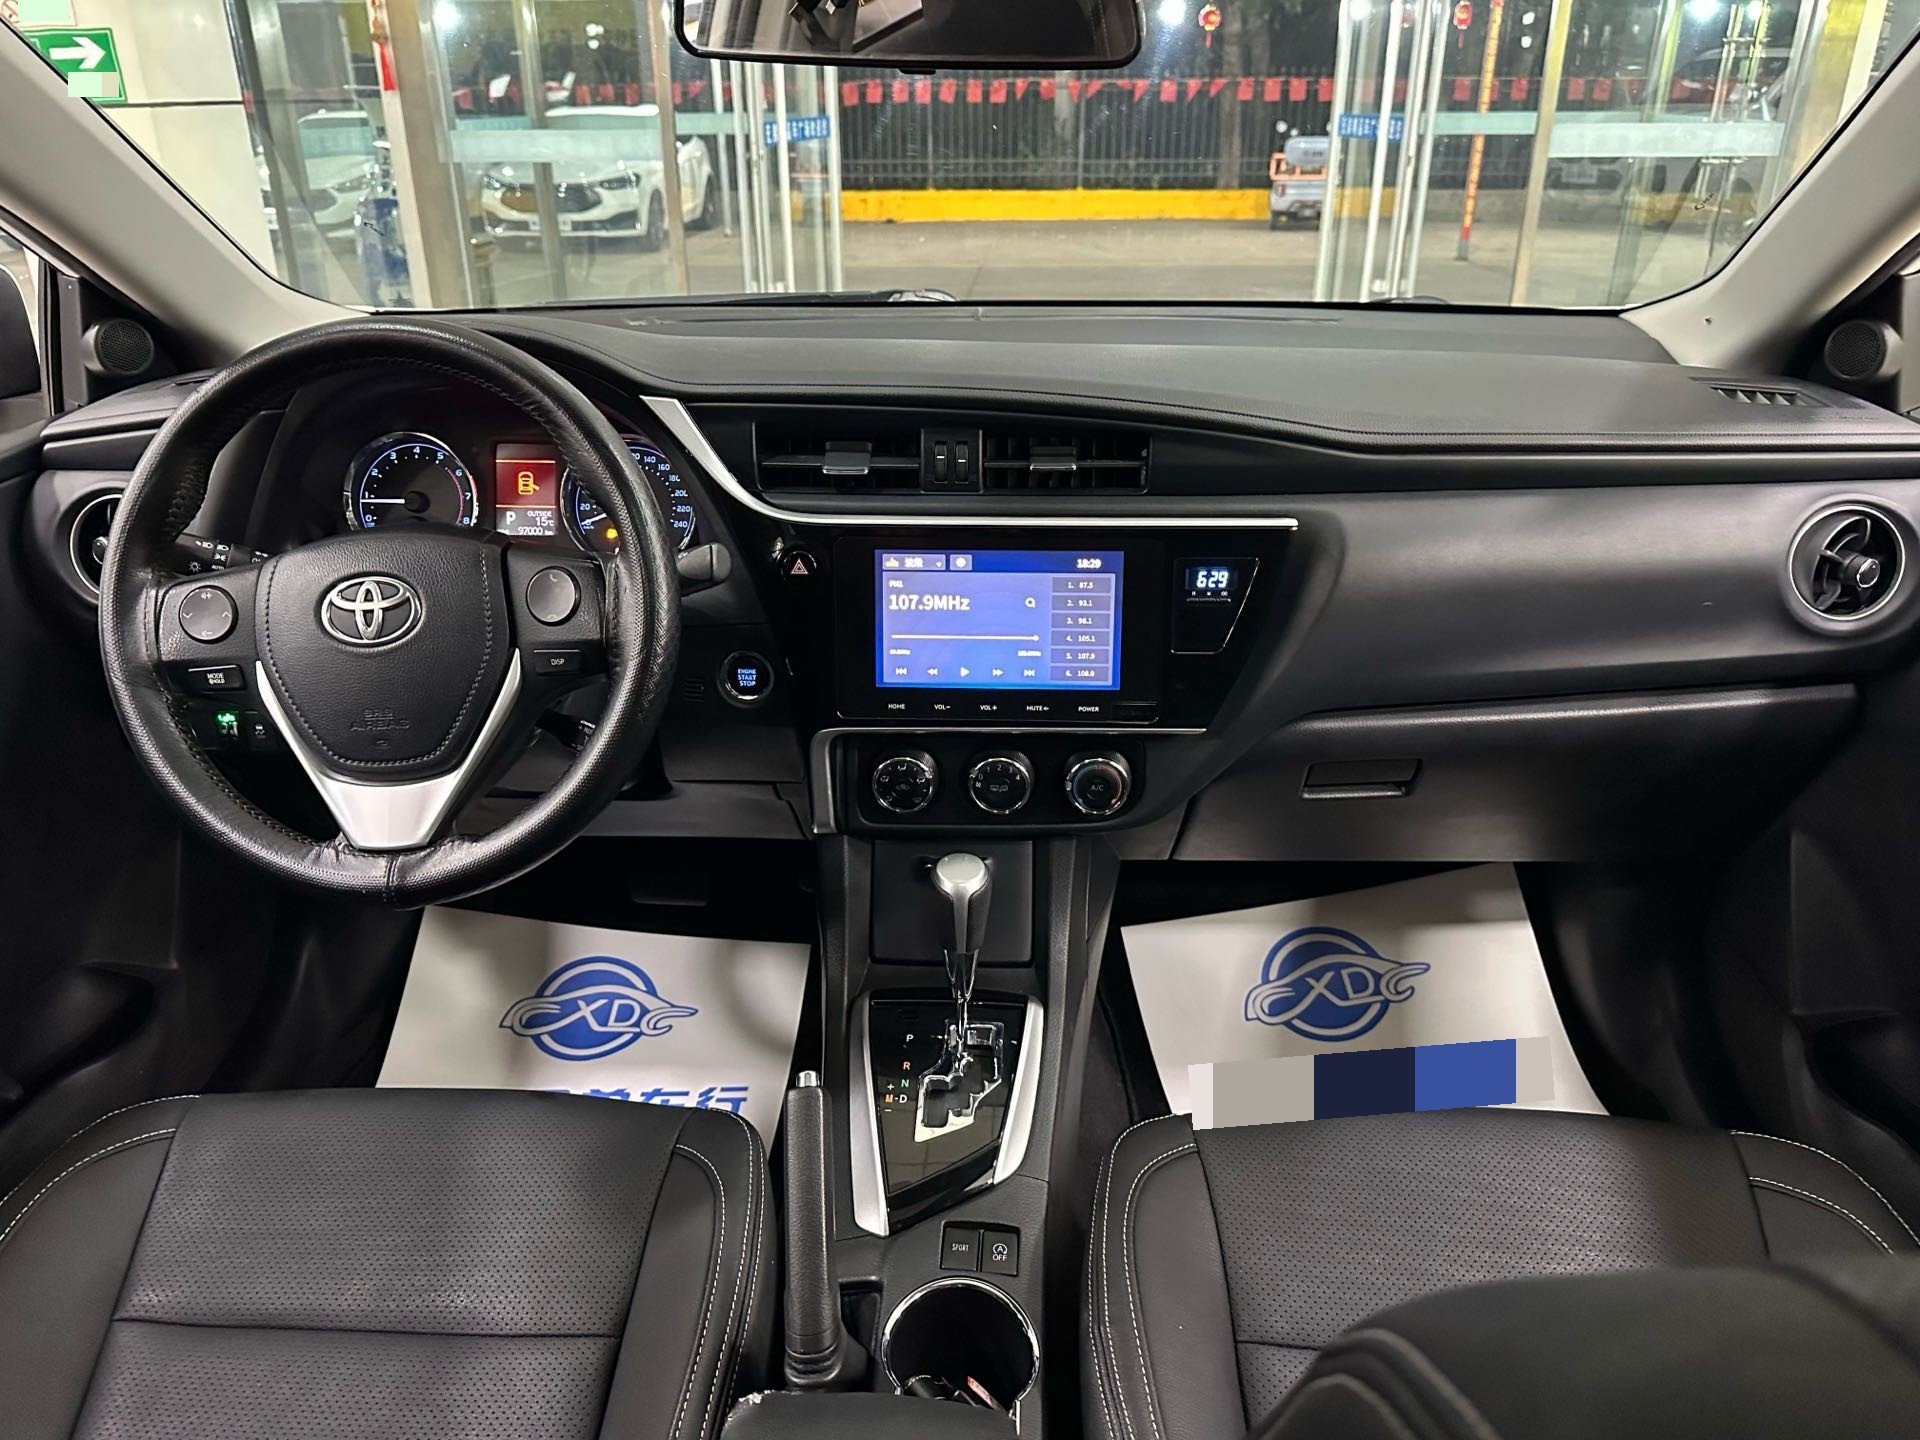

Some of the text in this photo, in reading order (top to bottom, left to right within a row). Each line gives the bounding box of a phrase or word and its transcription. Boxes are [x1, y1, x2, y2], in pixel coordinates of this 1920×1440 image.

[413, 446, 420, 454] 4
[390, 452, 397, 460] 3
[437, 452, 444, 460] 5
[643, 455, 656, 463] 140
[657, 463, 671, 471] 160
[371, 468, 379, 476] 2
[455, 469, 463, 477] 6
[464, 492, 472, 500] 7
[580, 503, 591, 511] 20
[676, 505, 691, 513] 220
[505, 510, 517, 526] P
[526, 510, 553, 518] OUTSIDE
[365, 514, 373, 523] 0
[462, 516, 470, 525] 8
[673, 520, 688, 528] 240
[1076, 558, 1102, 569] 18:29
[1078, 581, 1094, 590] 87.5
[888, 594, 971, 611] 107.9MHz
[1077, 652, 1096, 660] 107.9
[550, 658, 565, 666] DISP
[206, 672, 224, 680] MODE
[905, 1034, 914, 1043] P
[902, 1061, 911, 1070] R
[901, 1079, 910, 1088] N
[951, 1243, 969, 1252] SPORT
[992, 1253, 1008, 1261] OFF
